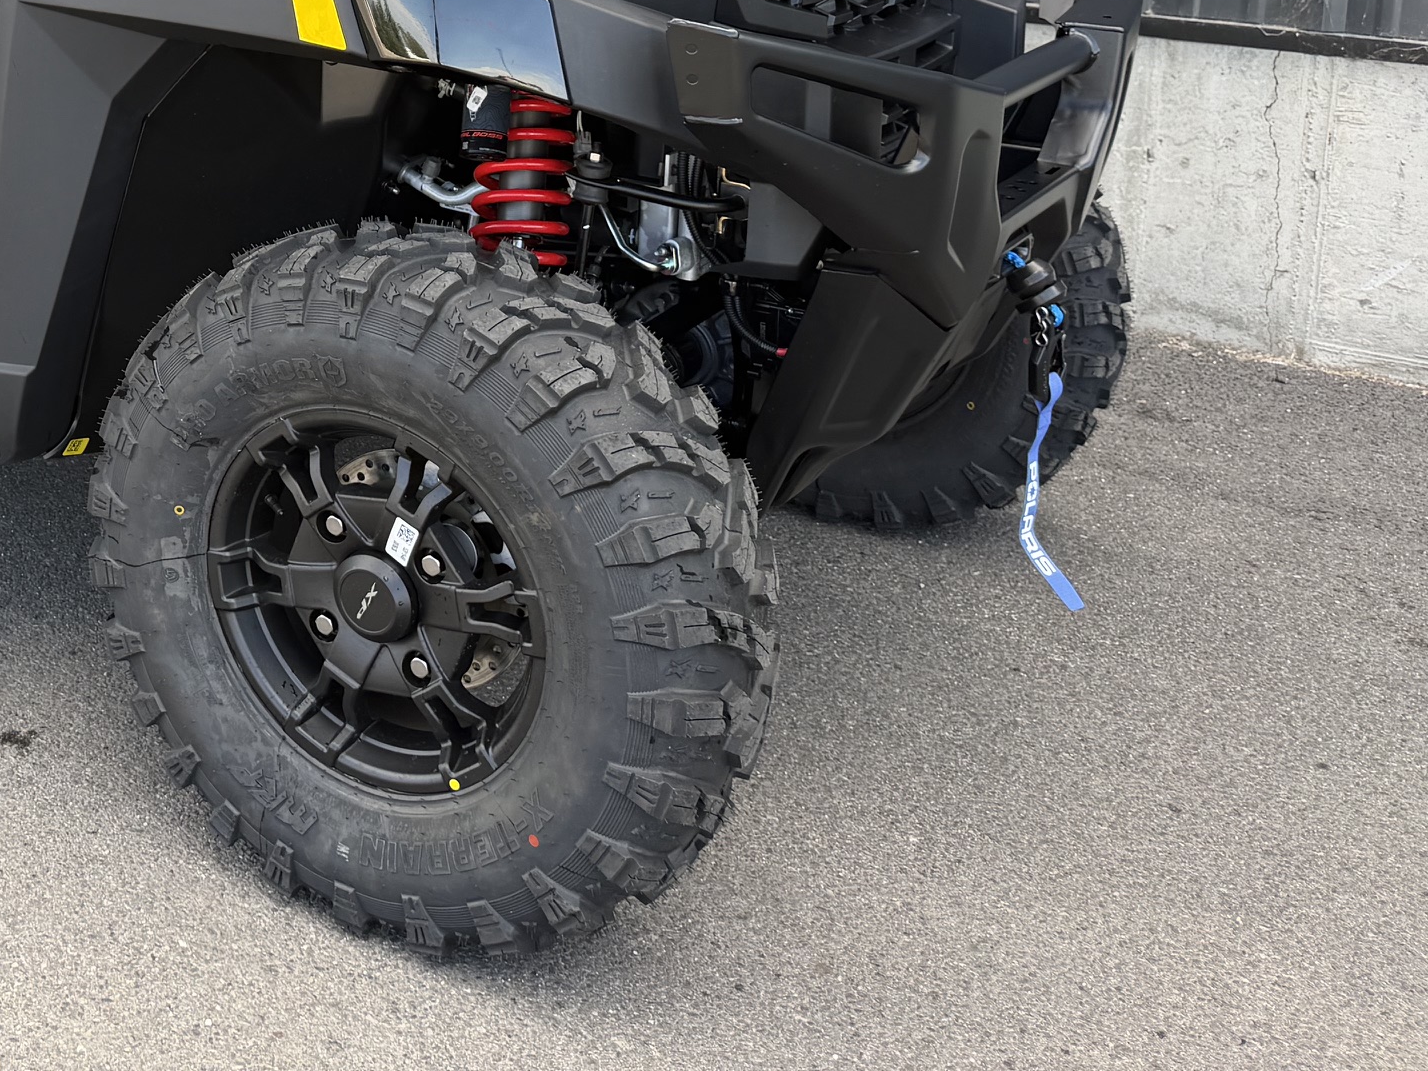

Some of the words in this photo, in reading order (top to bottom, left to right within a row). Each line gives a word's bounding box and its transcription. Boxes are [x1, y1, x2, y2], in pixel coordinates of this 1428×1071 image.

[1021, 460, 1057, 577] POLARIS
[356, 582, 378, 620] XP
[358, 786, 555, 875] X-TERRAIN
